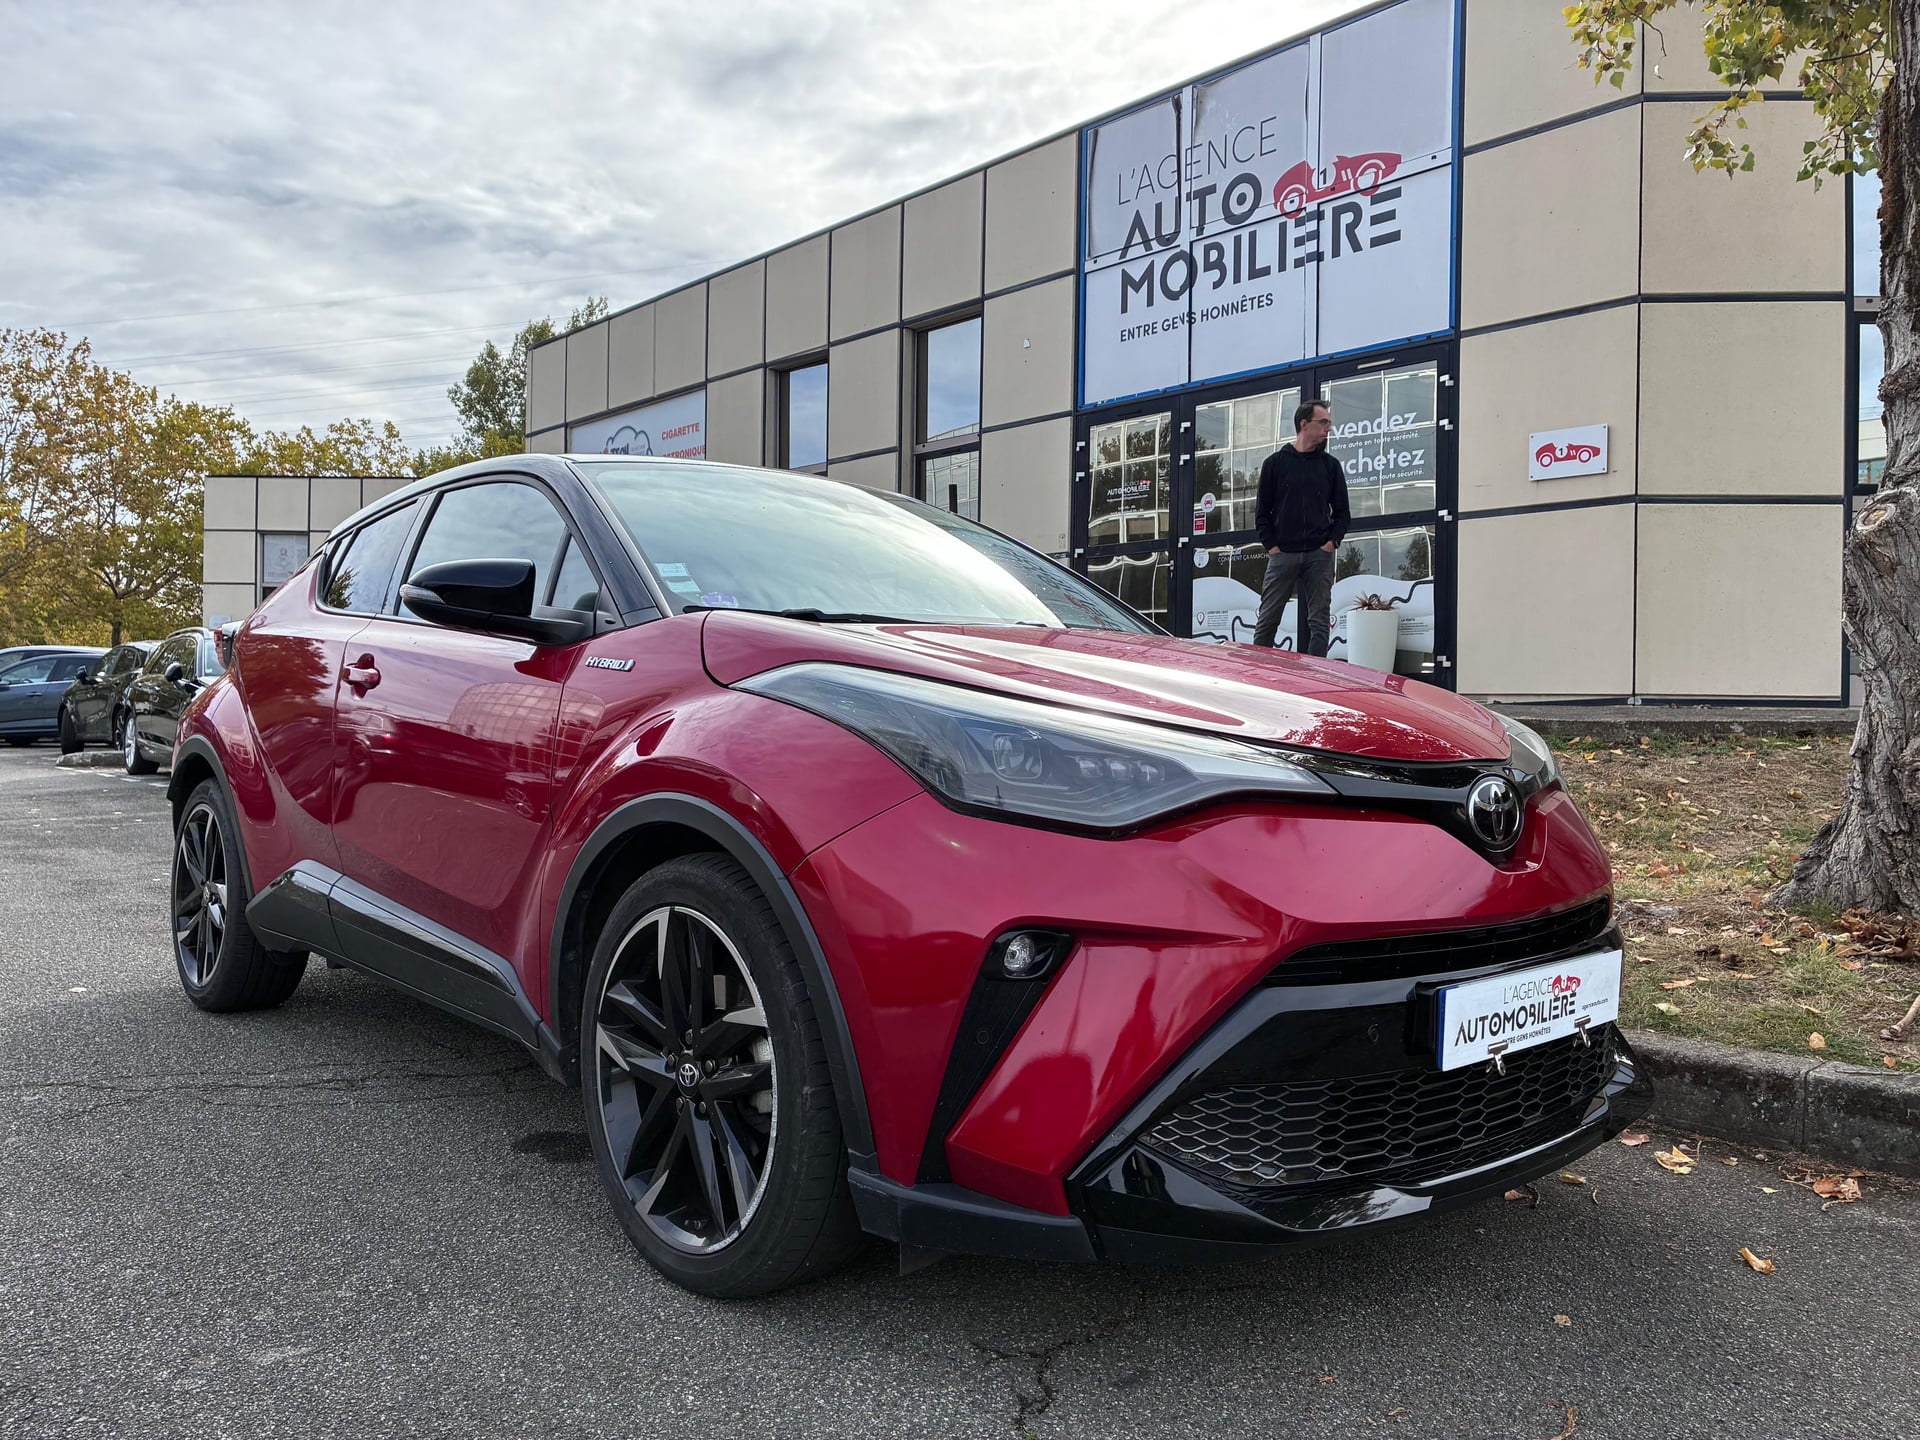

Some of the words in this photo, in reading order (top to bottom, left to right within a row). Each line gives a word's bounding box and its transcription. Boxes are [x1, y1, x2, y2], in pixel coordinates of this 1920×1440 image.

[1118, 116, 1277, 205] L'AGENCE
[1119, 172, 1262, 260] AUTO
[1120, 321, 1158, 343] ENTRE
[1161, 311, 1197, 332] GENS
[1200, 293, 1274, 324] HONNÊTES
[661, 422, 700, 440] CIGARETTE
[1332, 412, 1417, 439] vendez
[1348, 440, 1362, 448] auto
[1374, 436, 1391, 444] toute
[585, 656, 625, 670] HYBRID
[1503, 977, 1552, 1004] L'AGENCE
[1517, 1032, 1529, 1043] GENS
